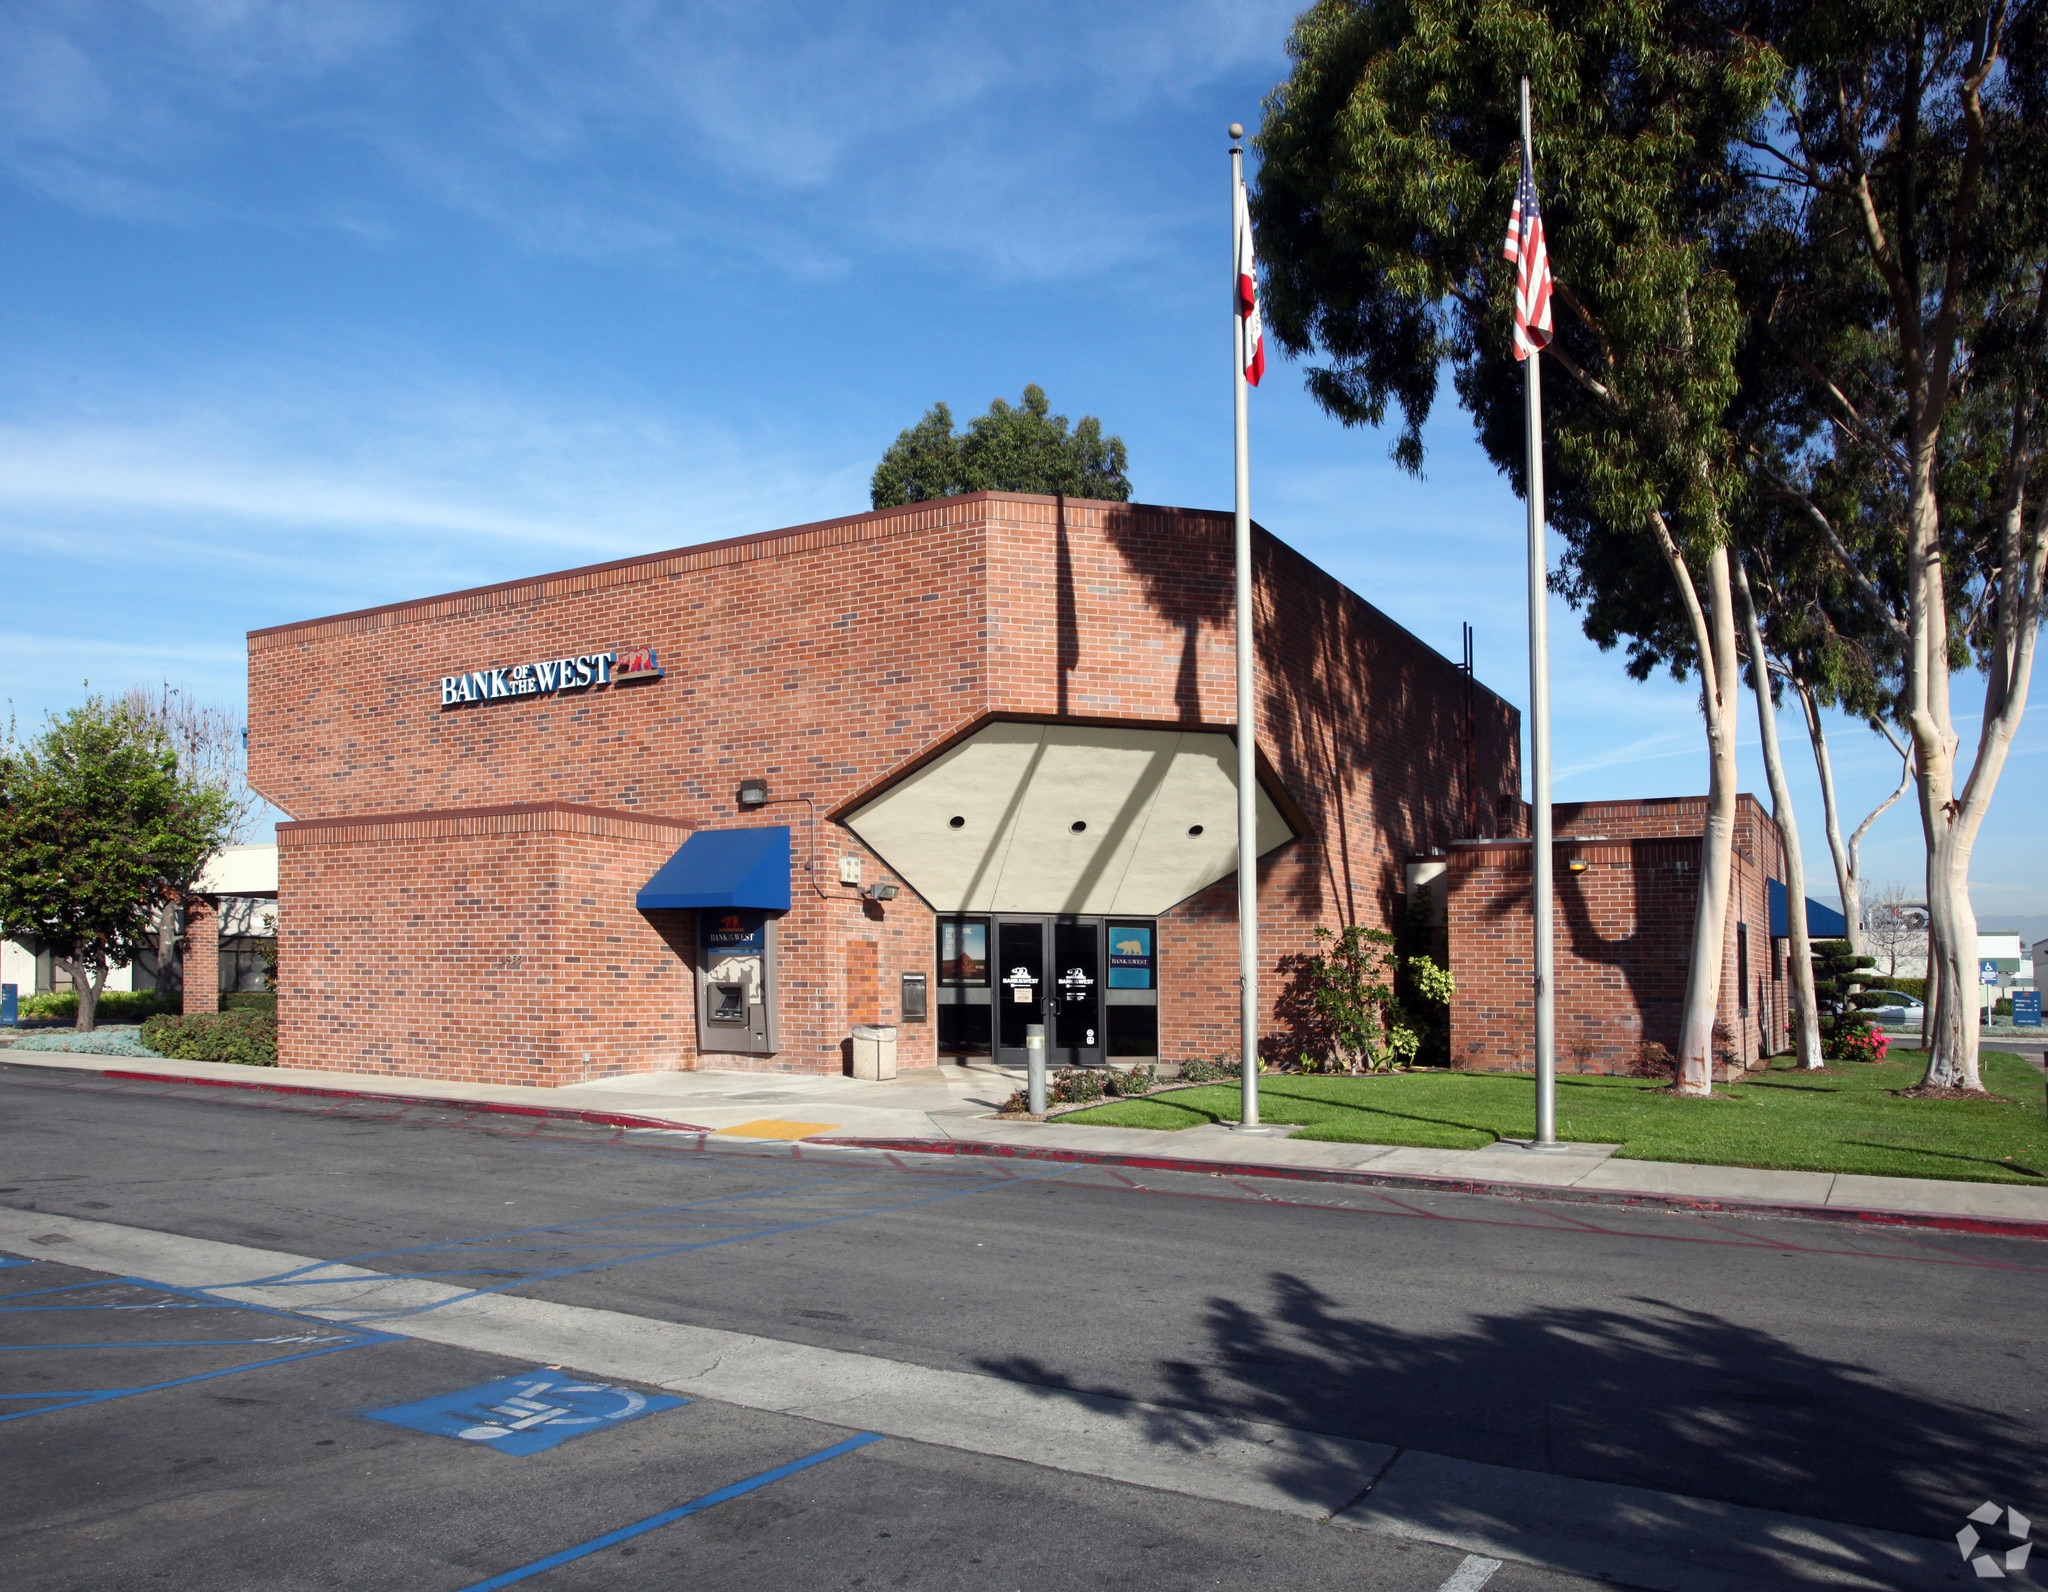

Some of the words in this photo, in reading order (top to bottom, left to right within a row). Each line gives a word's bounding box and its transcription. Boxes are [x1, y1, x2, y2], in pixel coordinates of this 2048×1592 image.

[513, 665, 531, 680] OF
[534, 652, 614, 693] WEST
[440, 667, 511, 706] BANK
[509, 678, 537, 695] THE
[710, 933, 729, 942] BANK
[734, 933, 755, 942] WEST
